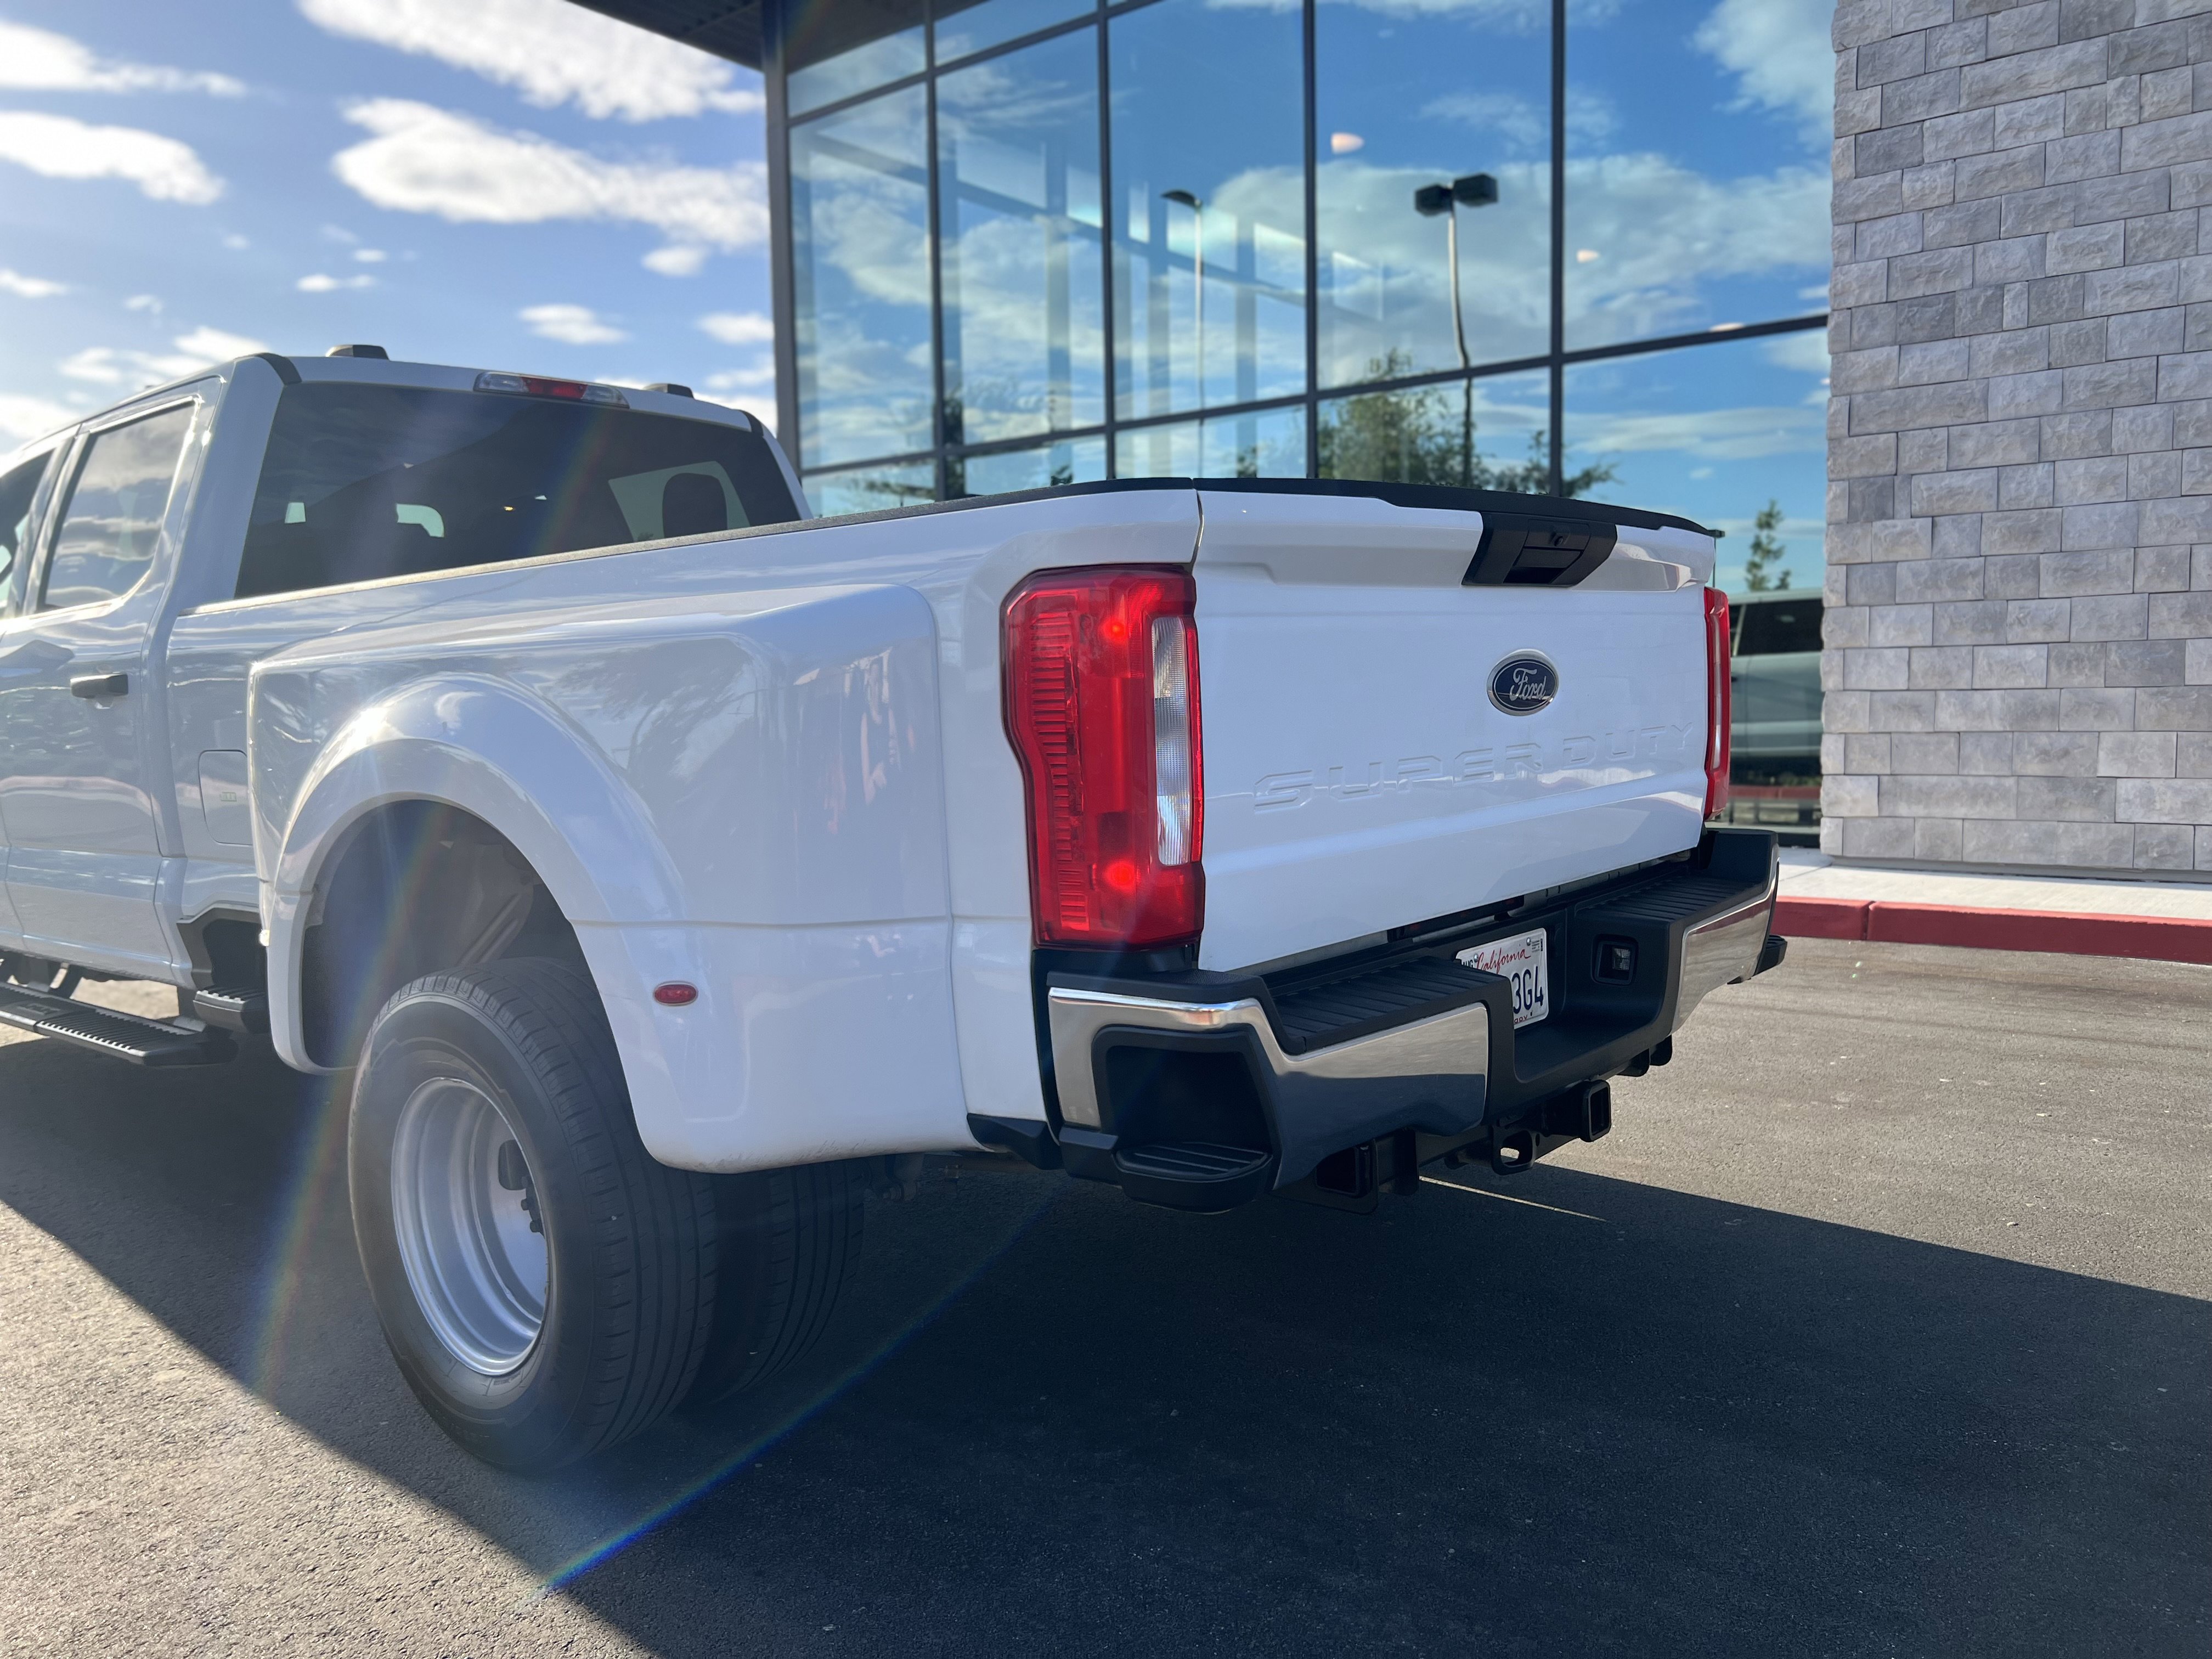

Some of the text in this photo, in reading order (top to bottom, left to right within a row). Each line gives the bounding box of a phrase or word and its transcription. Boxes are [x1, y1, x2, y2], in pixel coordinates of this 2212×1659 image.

[1509, 668, 1547, 702] Ford
[1254, 721, 1693, 815] SUPER DUTY
[1476, 947, 1531, 975] California
